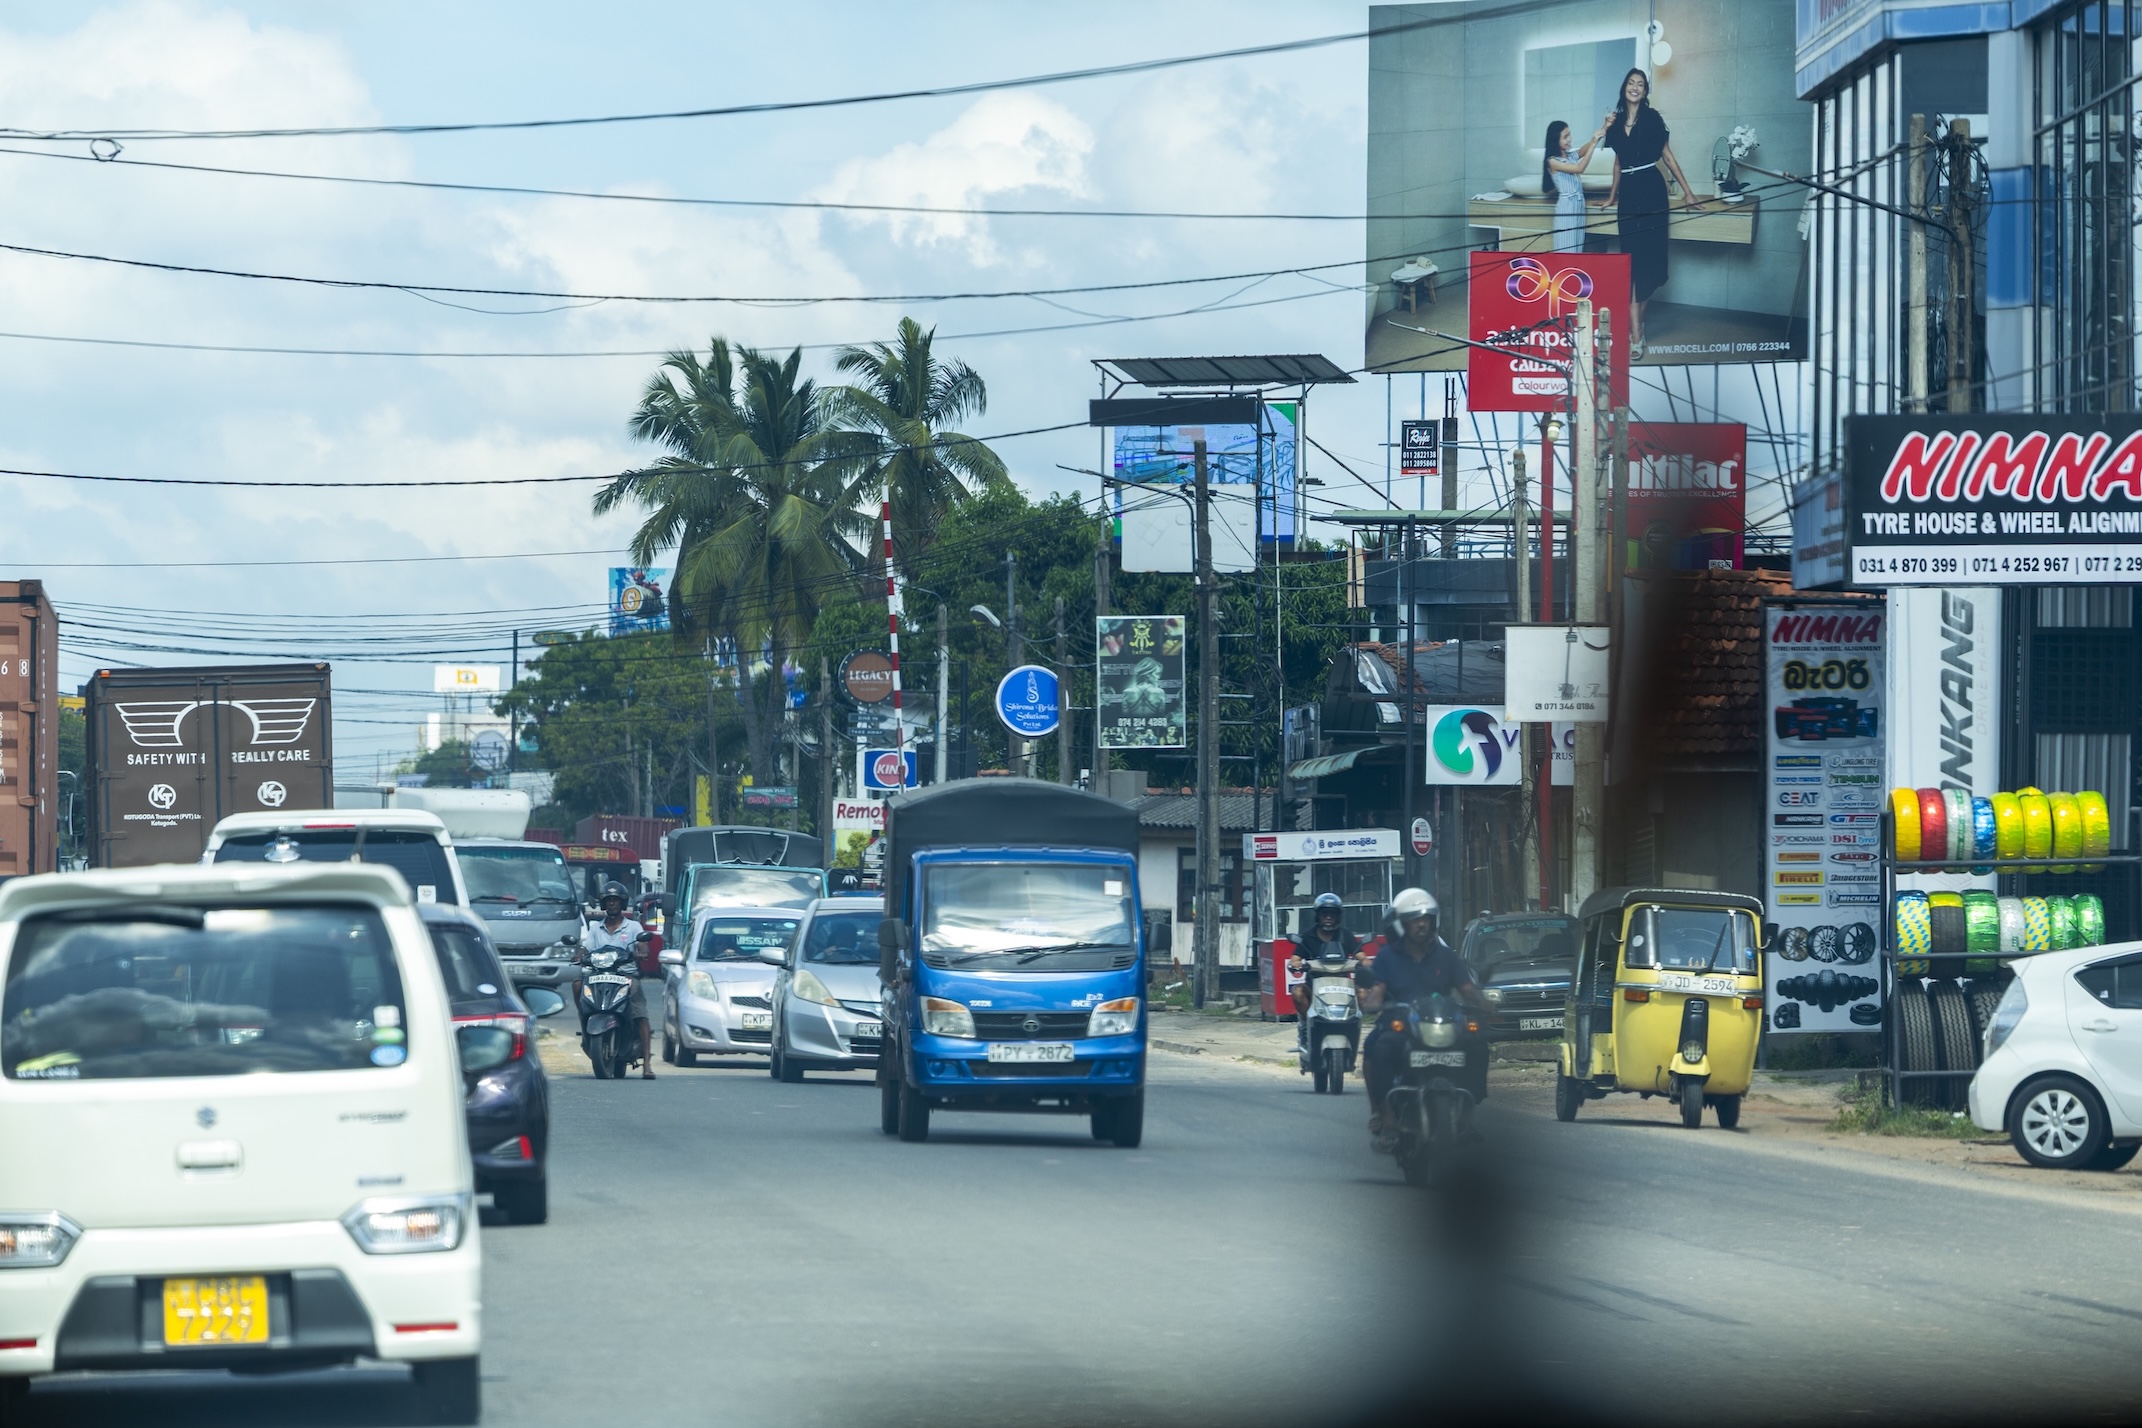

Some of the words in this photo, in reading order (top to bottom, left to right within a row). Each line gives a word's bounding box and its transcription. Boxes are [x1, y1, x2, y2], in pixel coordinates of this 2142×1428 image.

[1648, 343, 1730, 355] WWW.ROCELL.COM
[1736, 342, 1757, 352] 0766
[1759, 341, 1790, 351] 223344
[1880, 430, 2142, 504] NIMNA
[1862, 512, 1910, 535] TYRE
[1914, 512, 1977, 535] HOUSE
[1981, 512, 1996, 534] &
[2000, 511, 2064, 534] WHEEL
[2068, 511, 2142, 533] ALIGNM
[1859, 558, 1885, 573] 031
[1889, 558, 1897, 572] 4
[1901, 558, 1927, 573] 870
[1932, 558, 1957, 572] 399
[1972, 557, 1997, 572] 071
[2001, 557, 2010, 572] 4
[2014, 557, 2040, 572] 252
[2044, 557, 2069, 572] 967
[2085, 557, 2109, 572] 077
[2114, 557, 2122, 571] 2
[1772, 614, 1882, 643] NIMNA
[21, 661, 28, 675] 8
[849, 670, 891, 680] LEGACY
[1118, 718, 1131, 726] 074
[127, 753, 173, 765] SAFETY
[231, 751, 275, 763] REALLY
[277, 750, 310, 761] CARE
[1834, 775, 1879, 784] TIMSUN
[1780, 792, 1818, 804] CEAT
[155, 813, 179, 821] Transport
[602, 828, 628, 843] tex
[1832, 834, 1857, 843] DSI
[1858, 836, 1877, 844] Tyres
[1779, 873, 1819, 883] PIRELLI
[1831, 874, 1878, 882] BRIDGESTONE
[1703, 979, 1733, 991] 2594
[752, 1016, 765, 1025] KP
[1530, 1019, 1541, 1028] KL
[1004, 1046, 1021, 1060] PY
[1038, 1046, 1073, 1060] 2872
